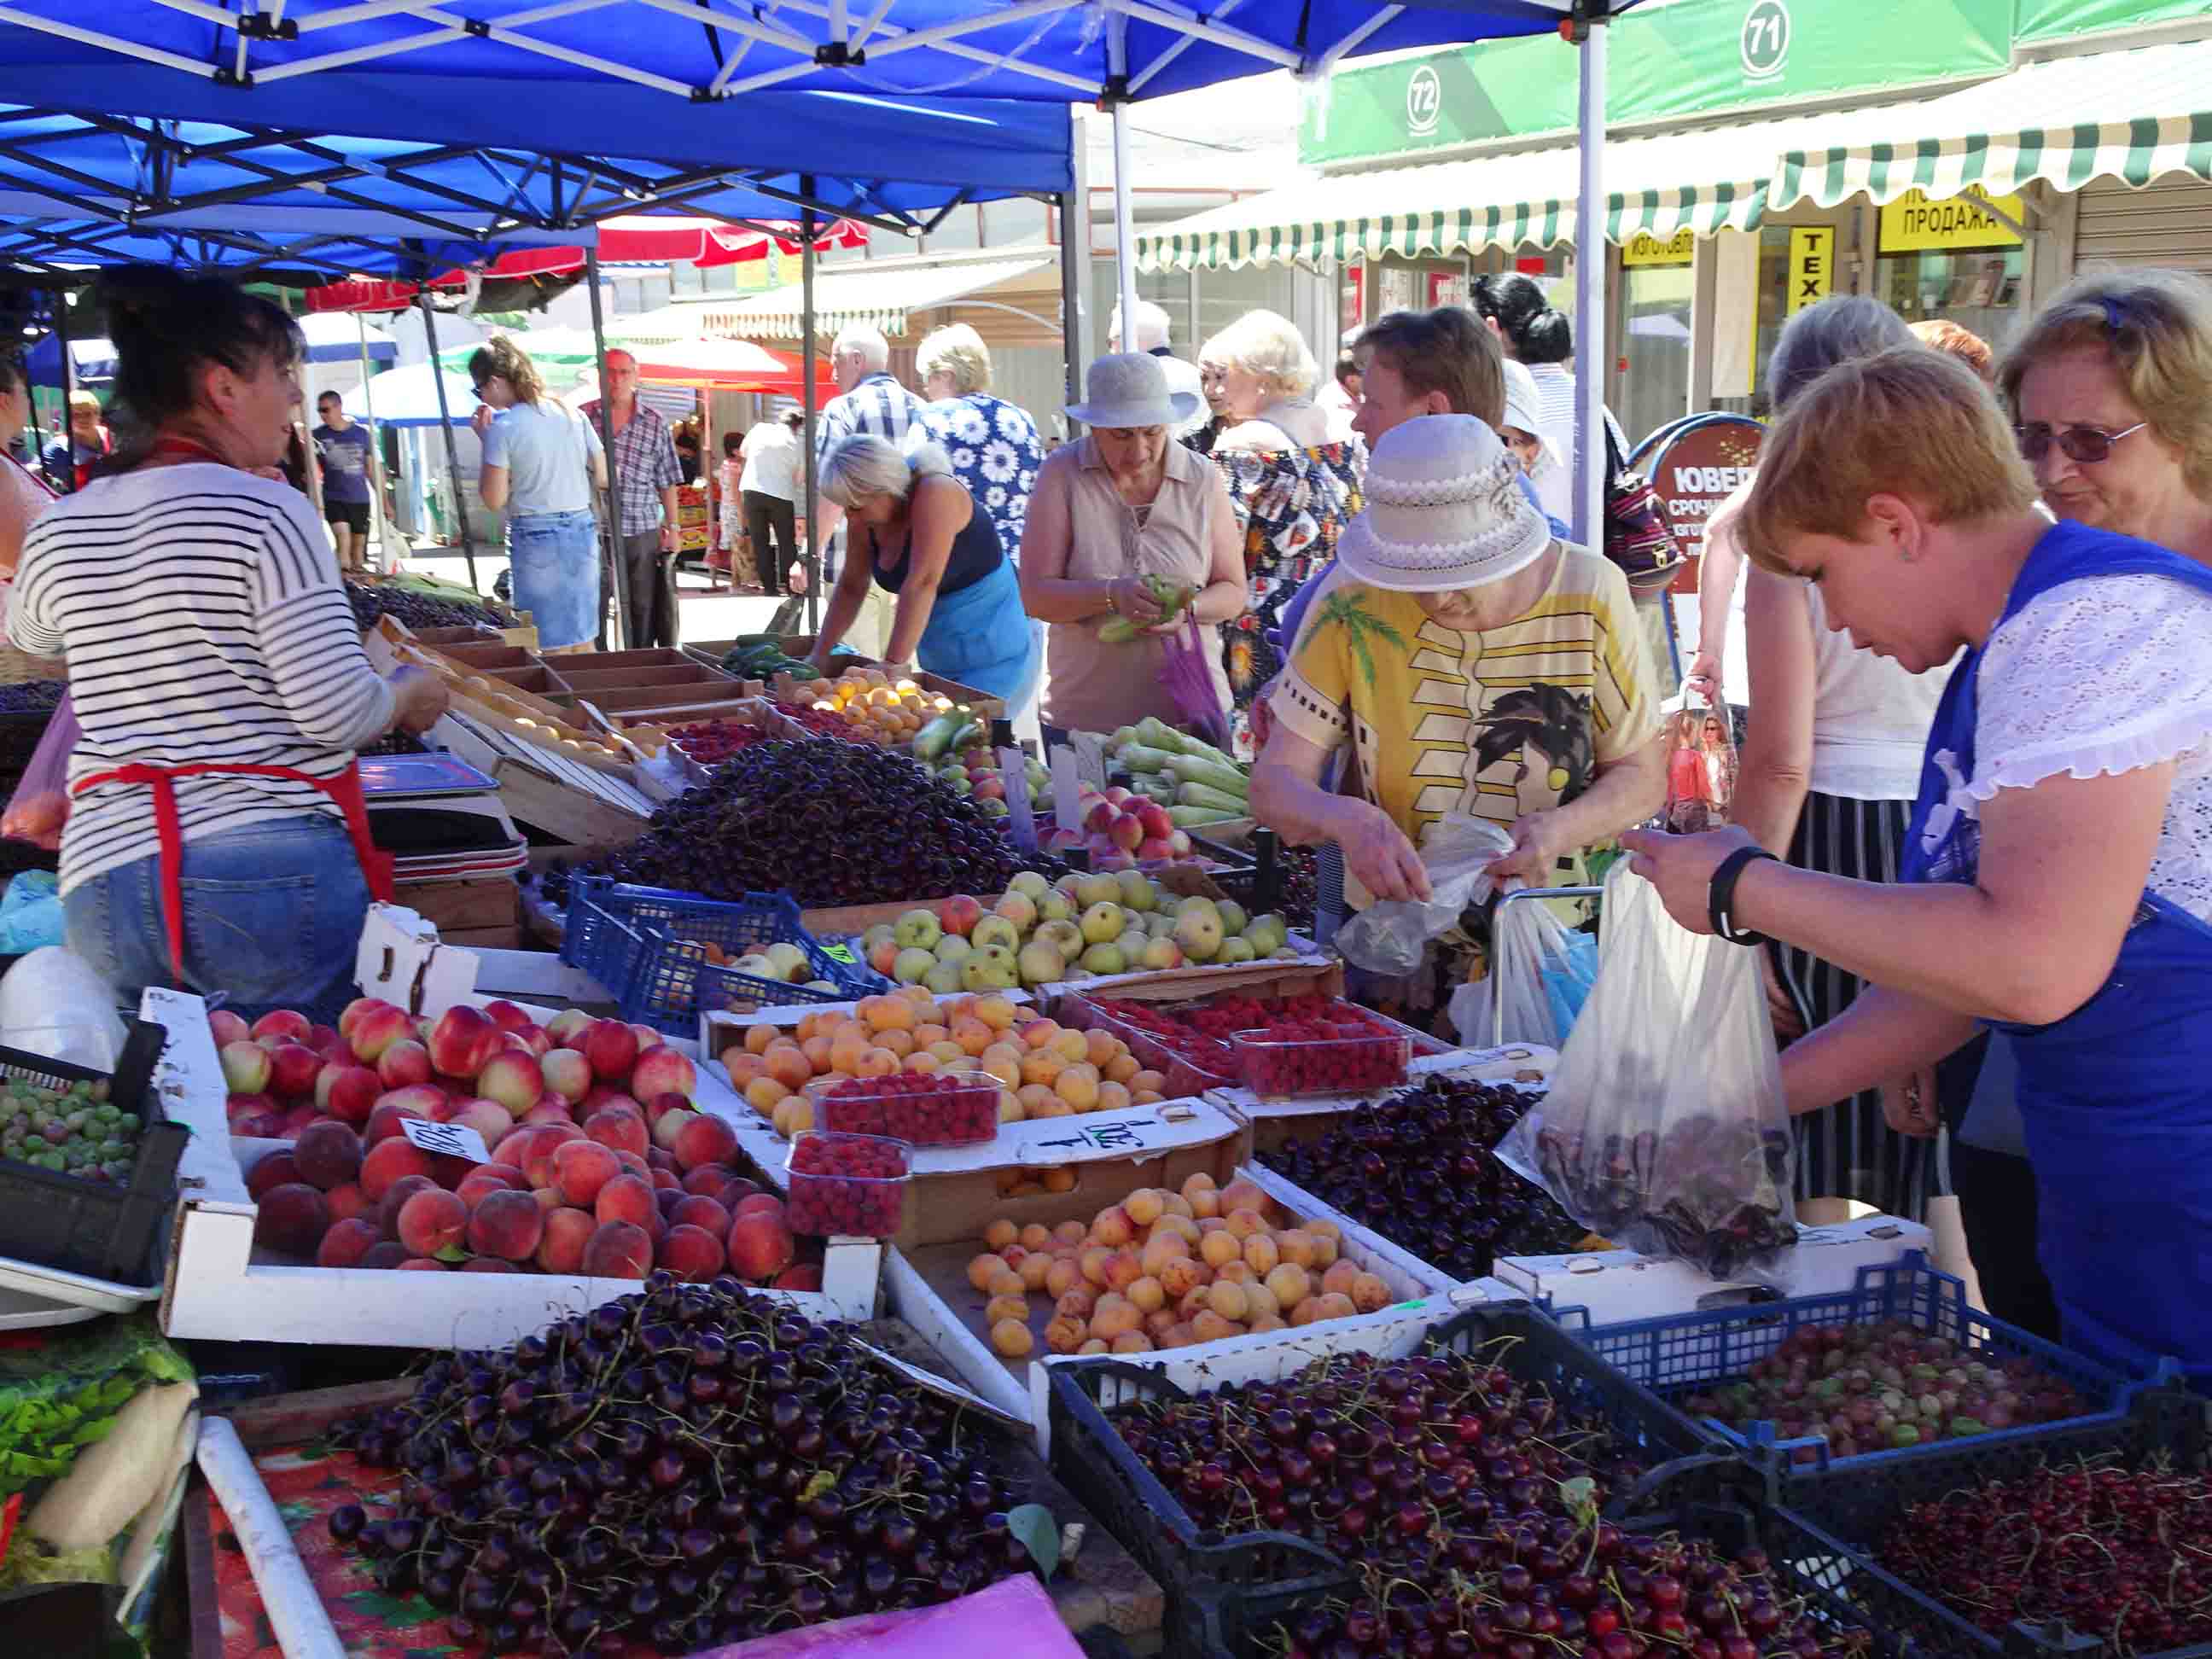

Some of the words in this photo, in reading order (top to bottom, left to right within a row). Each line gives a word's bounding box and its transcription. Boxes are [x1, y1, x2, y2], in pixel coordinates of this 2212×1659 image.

[1749, 15, 1780, 55] 71
[1412, 80, 1435, 113] 72
[1904, 206, 1998, 236] ПРОДАЖА
[1800, 234, 1823, 309] ТЕХ
